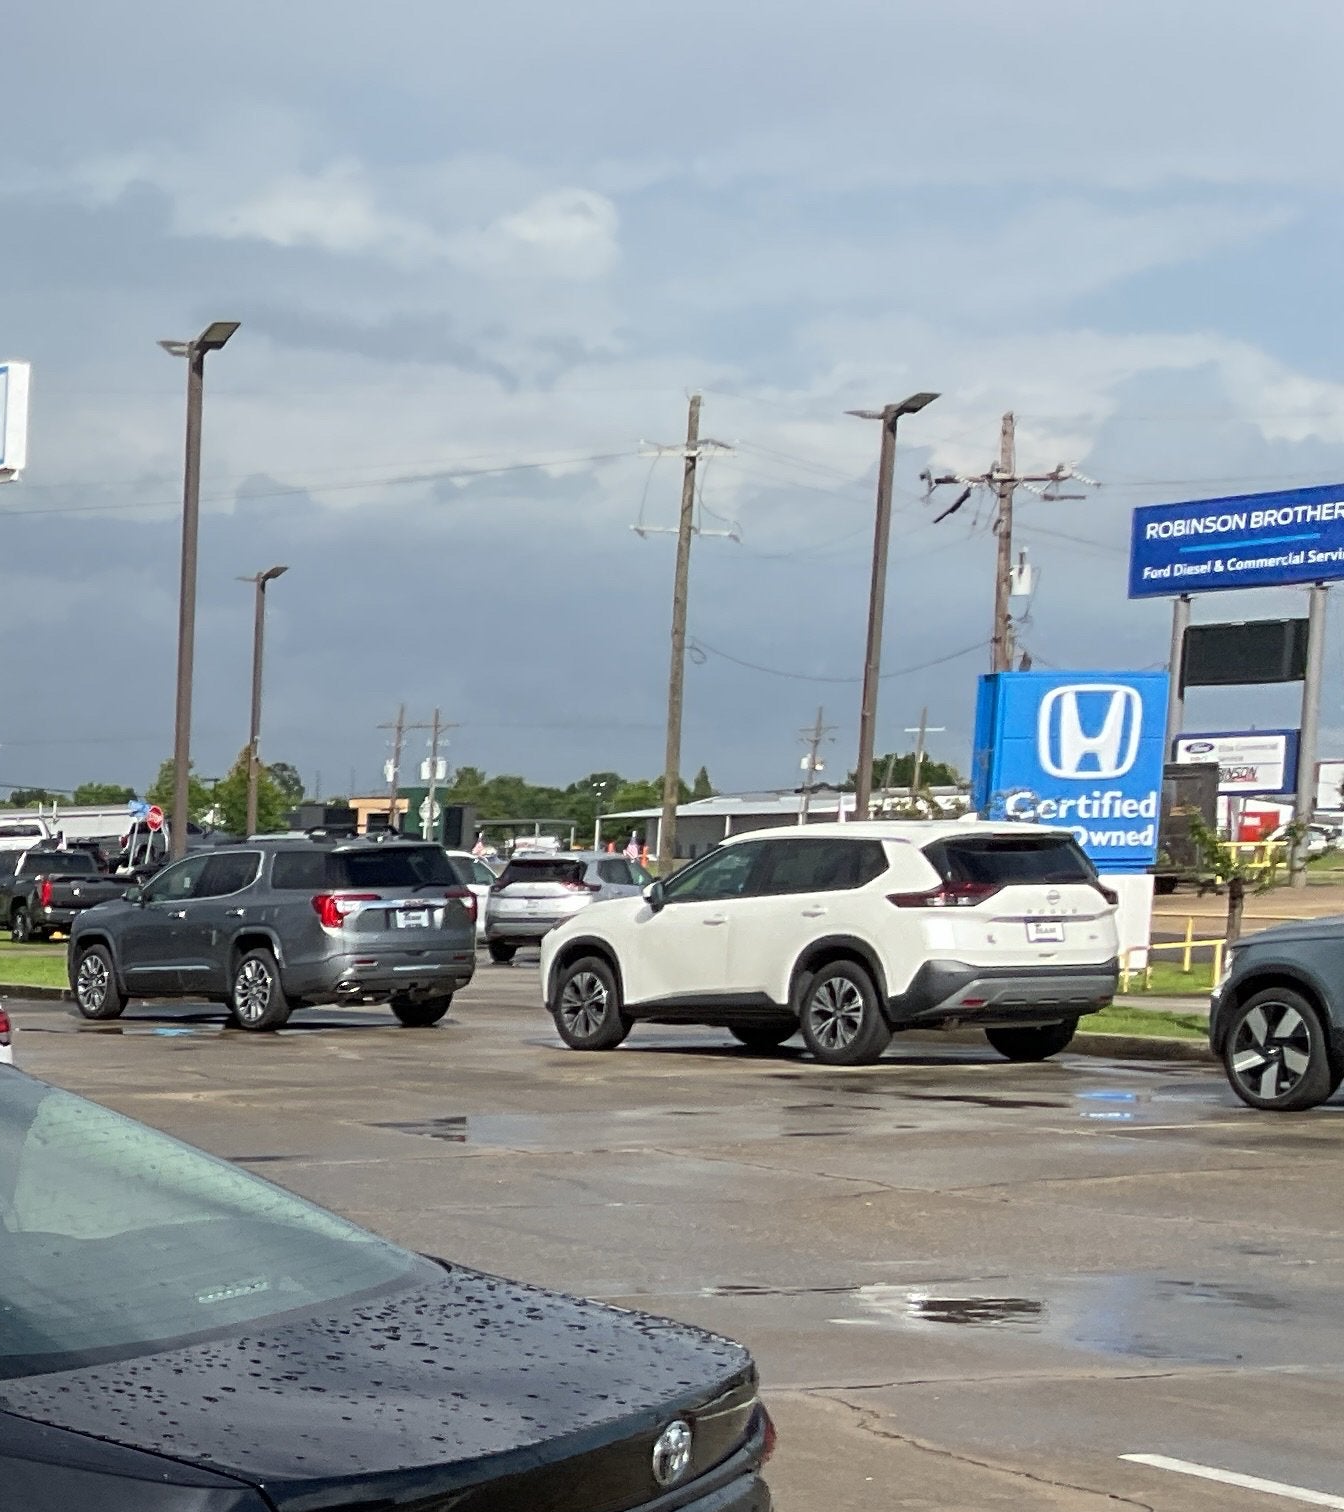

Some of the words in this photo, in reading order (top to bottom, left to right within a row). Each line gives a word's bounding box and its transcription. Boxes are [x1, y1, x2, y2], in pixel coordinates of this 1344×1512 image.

[1145, 512, 1247, 540] ROBINSON
[1250, 501, 1344, 529] BROTHER
[1142, 564, 1171, 580] Ford
[1173, 560, 1212, 577] Diesel
[1214, 559, 1224, 573] &
[1226, 550, 1305, 572] Commercial
[1308, 547, 1344, 564] Servi
[1005, 789, 1157, 820] Certified
